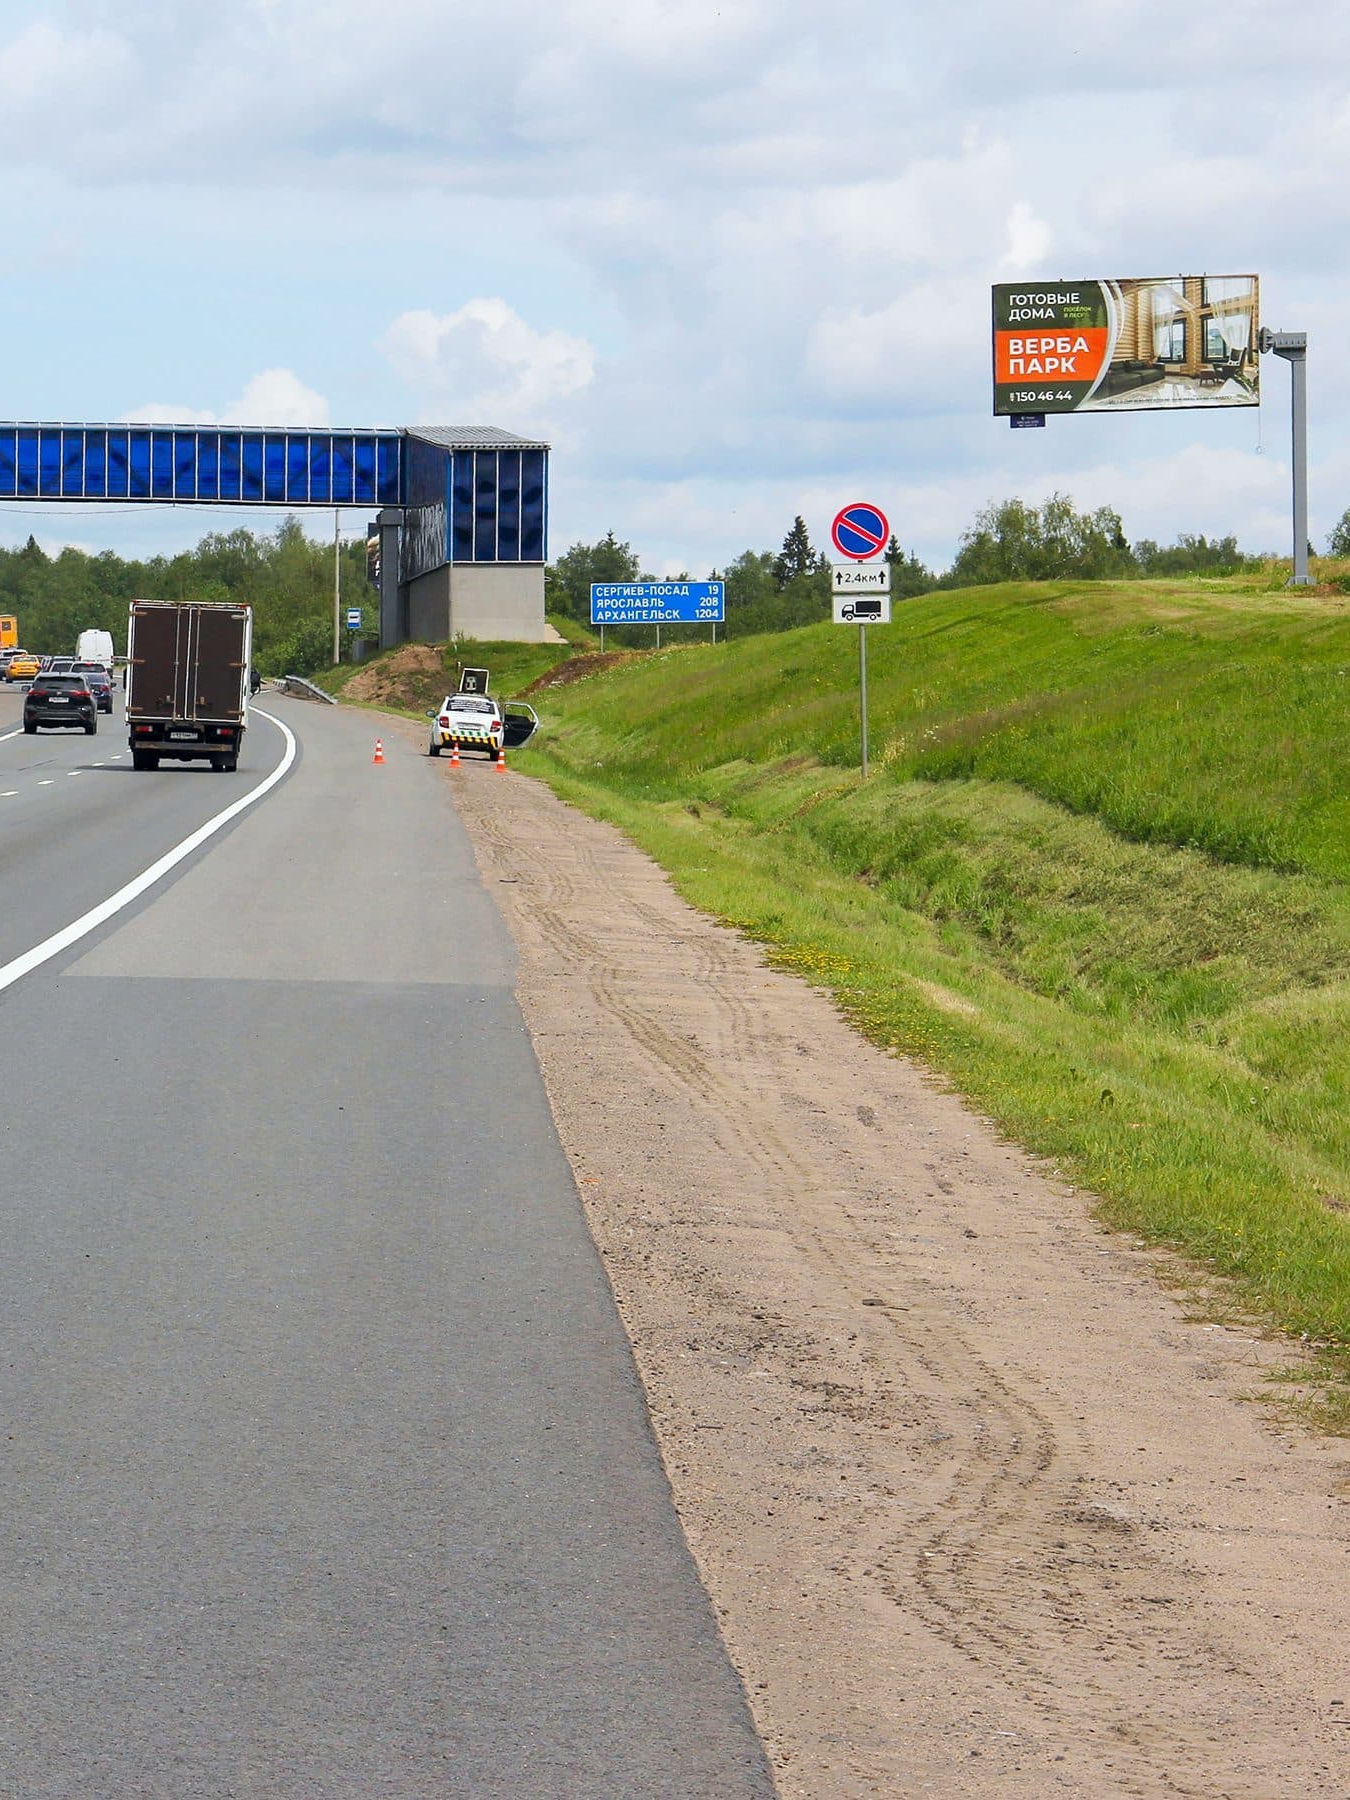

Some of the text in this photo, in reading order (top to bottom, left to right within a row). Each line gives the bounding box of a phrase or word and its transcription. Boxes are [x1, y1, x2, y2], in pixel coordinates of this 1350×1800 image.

[1010, 293, 1080, 306] ГОТОВЫЕ
[1009, 308, 1055, 321] ДОМА
[1010, 337, 1089, 355] ВЕРБА
[1010, 357, 1076, 374] ПАРК
[1016, 392, 1036, 401] 150
[1038, 391, 1054, 401] 46
[1055, 391, 1073, 400] 44
[596, 585, 719, 597] СЕРГИЕВ-ПОСАД 19
[596, 597, 719, 608] ЯРОСЛАВЛЬ 208
[596, 609, 719, 620] АРХАНГЕЛЬСК 1204
